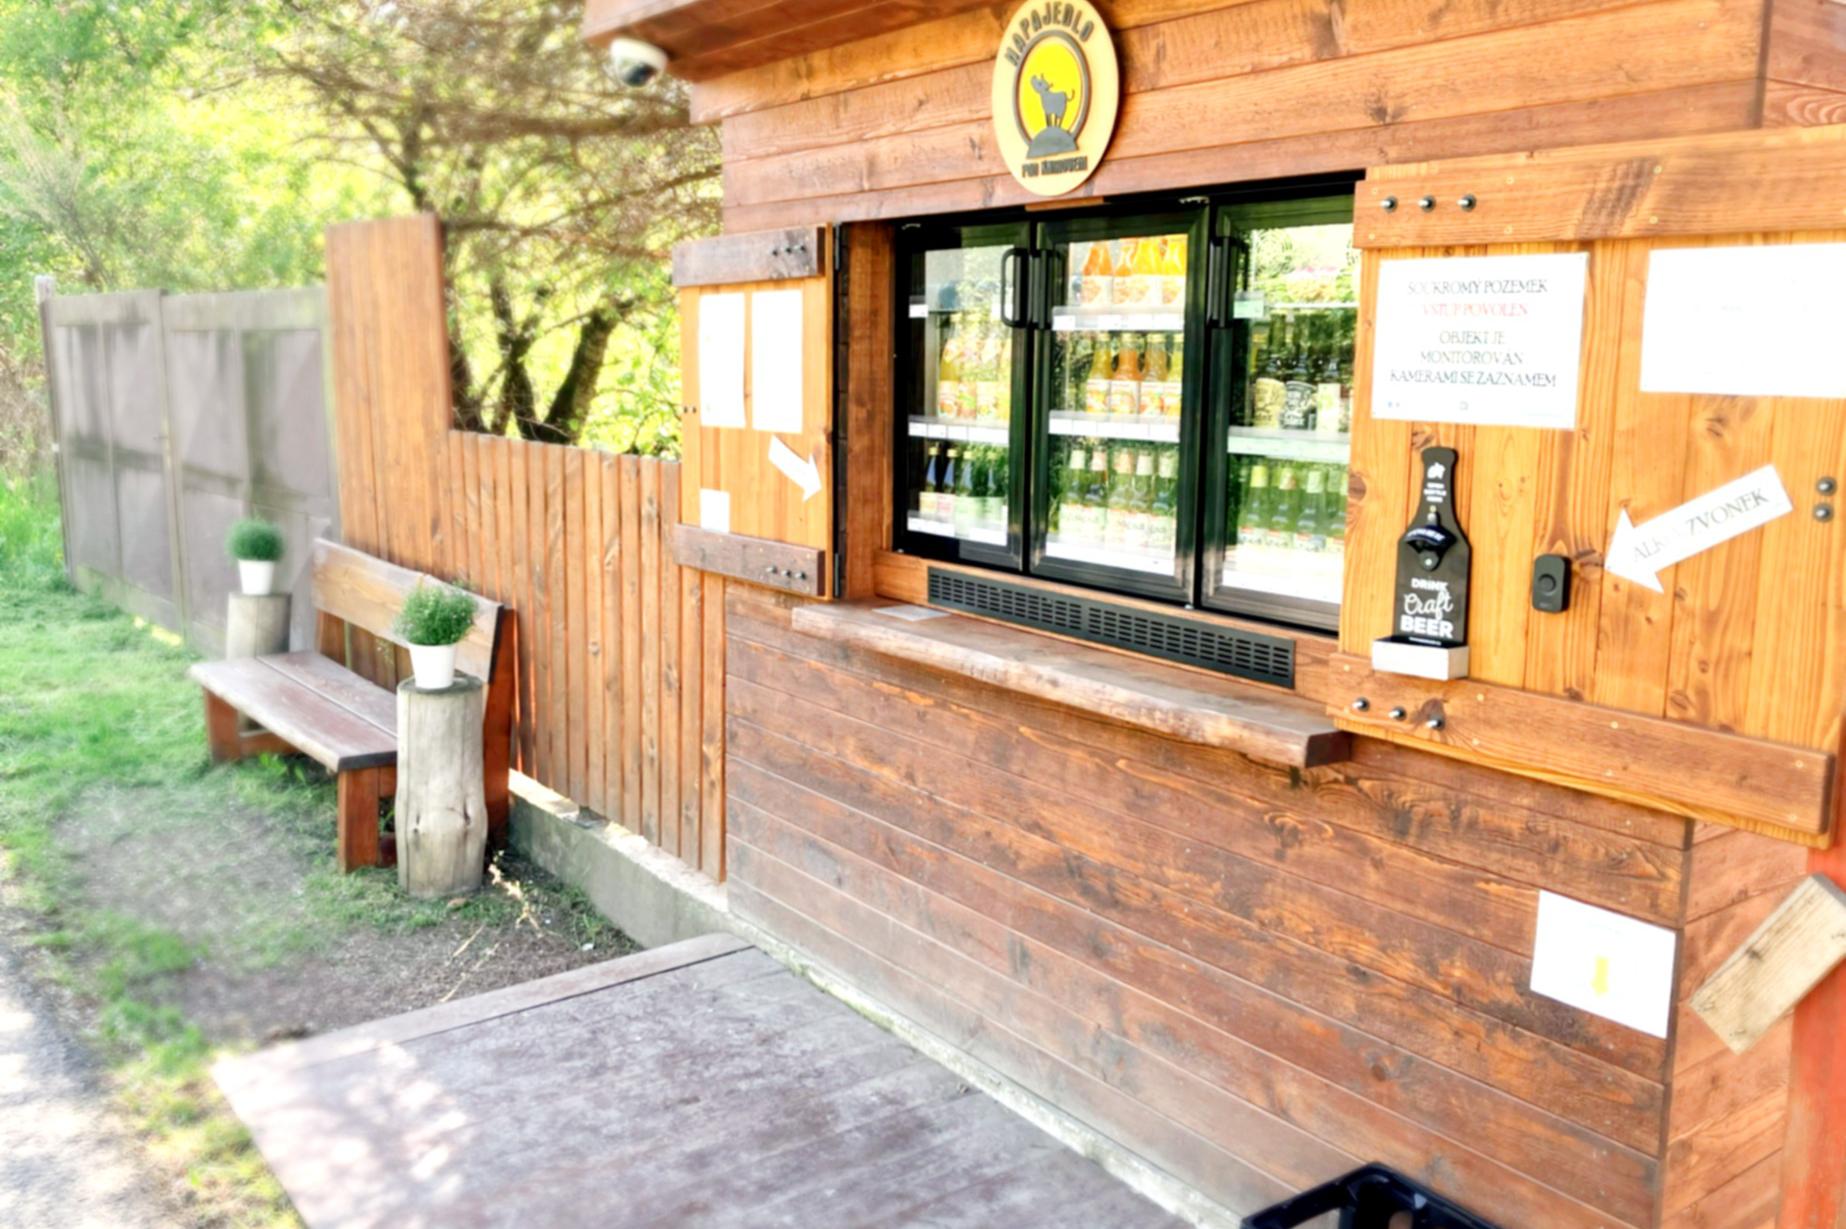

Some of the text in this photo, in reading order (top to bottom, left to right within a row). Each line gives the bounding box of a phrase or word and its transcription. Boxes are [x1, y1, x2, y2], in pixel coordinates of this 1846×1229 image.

[1484, 278, 1549, 294] POZEMEK
[1463, 303, 1528, 317] POVOLEN
[1439, 330, 1505, 345] OBJEKT JE
[1389, 369, 1458, 384] KAMERAMI
[1460, 370, 1475, 385] SE
[1686, 488, 1770, 535] ZVONEK
[1411, 578, 1448, 591] DRINK
[1403, 590, 1454, 620] Craft
[1400, 614, 1454, 639] BEER
